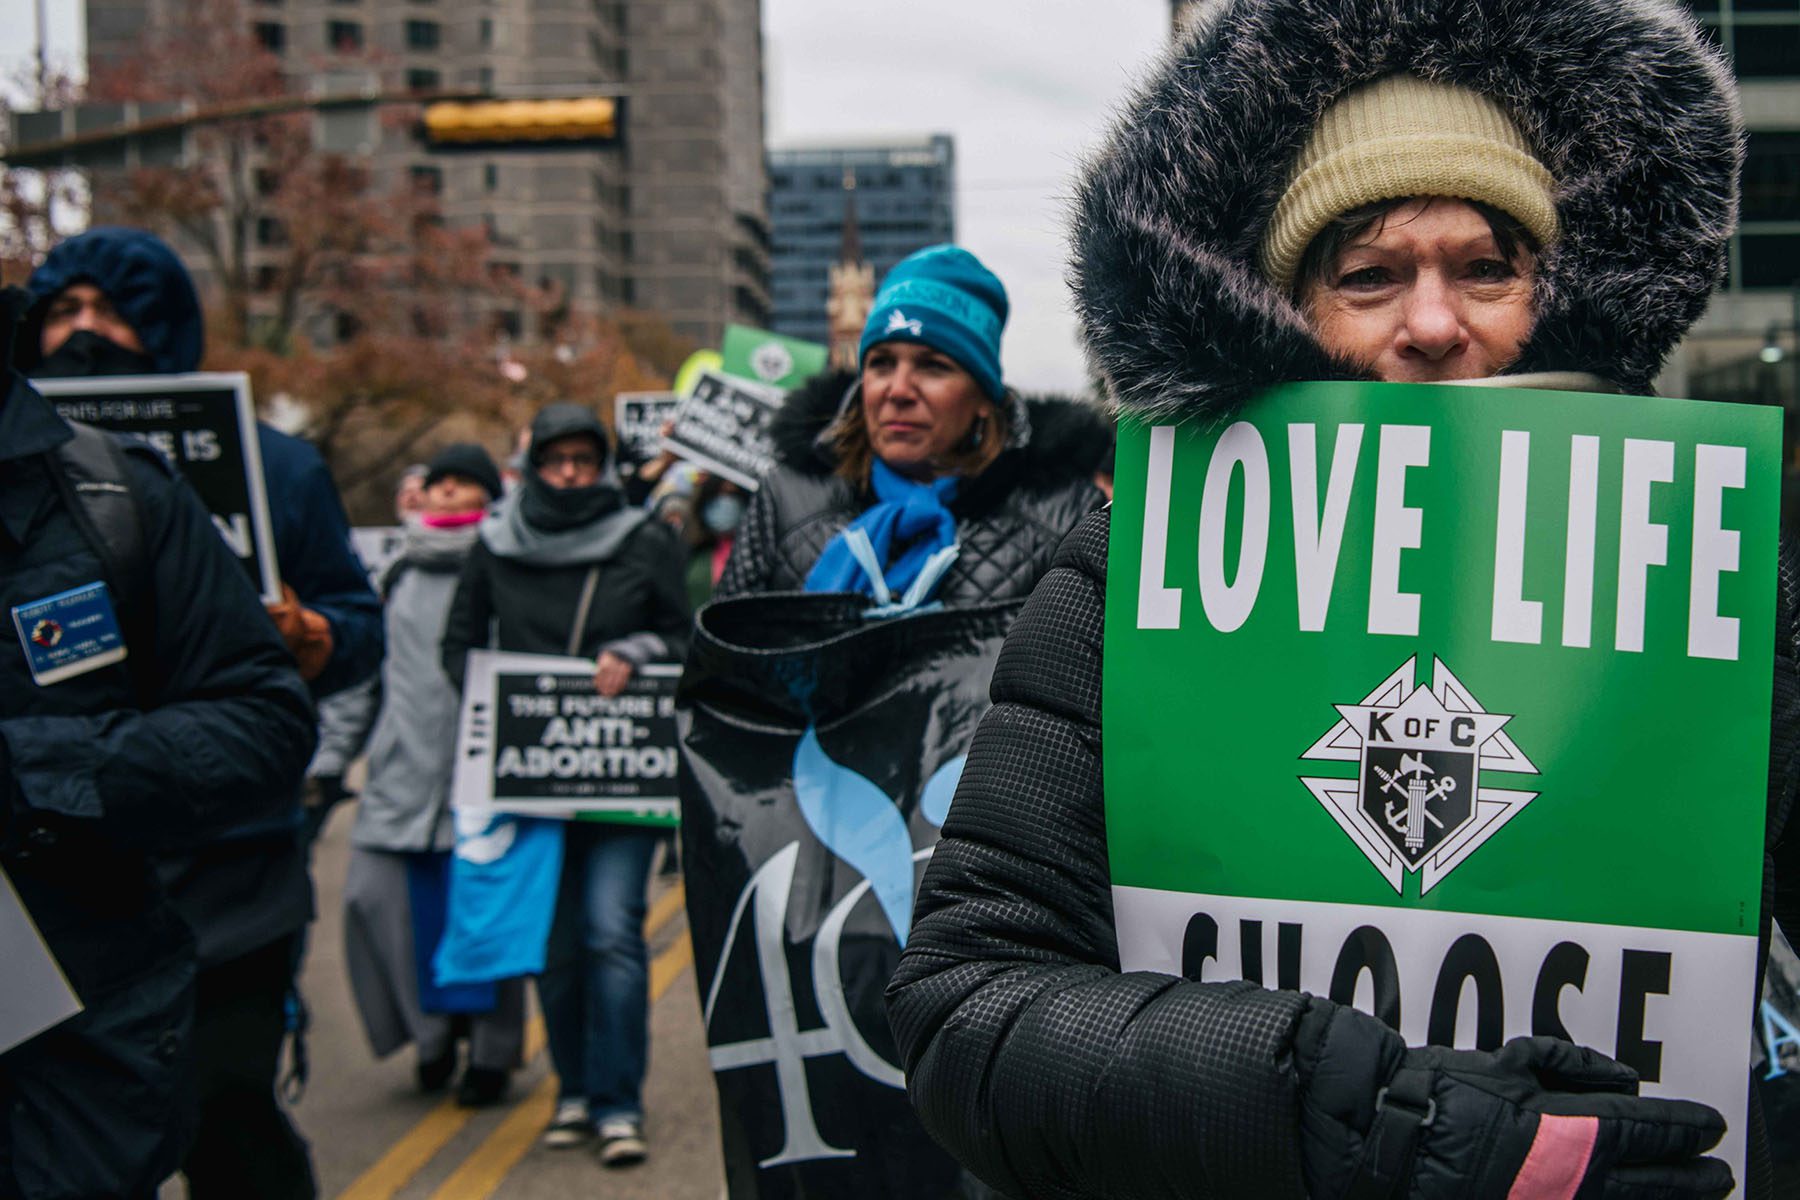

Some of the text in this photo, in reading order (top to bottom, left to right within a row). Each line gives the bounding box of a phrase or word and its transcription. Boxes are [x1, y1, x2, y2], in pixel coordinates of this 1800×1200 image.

[101, 400, 137, 419] FOR
[139, 398, 176, 418] LIFE
[182, 429, 221, 461] IS
[1136, 420, 1747, 661] LOVE LIFE
[508, 695, 557, 717] THE
[561, 695, 654, 717] FUTURE
[540, 716, 650, 746] ANTI-
[1368, 711, 1476, 747] K OF C
